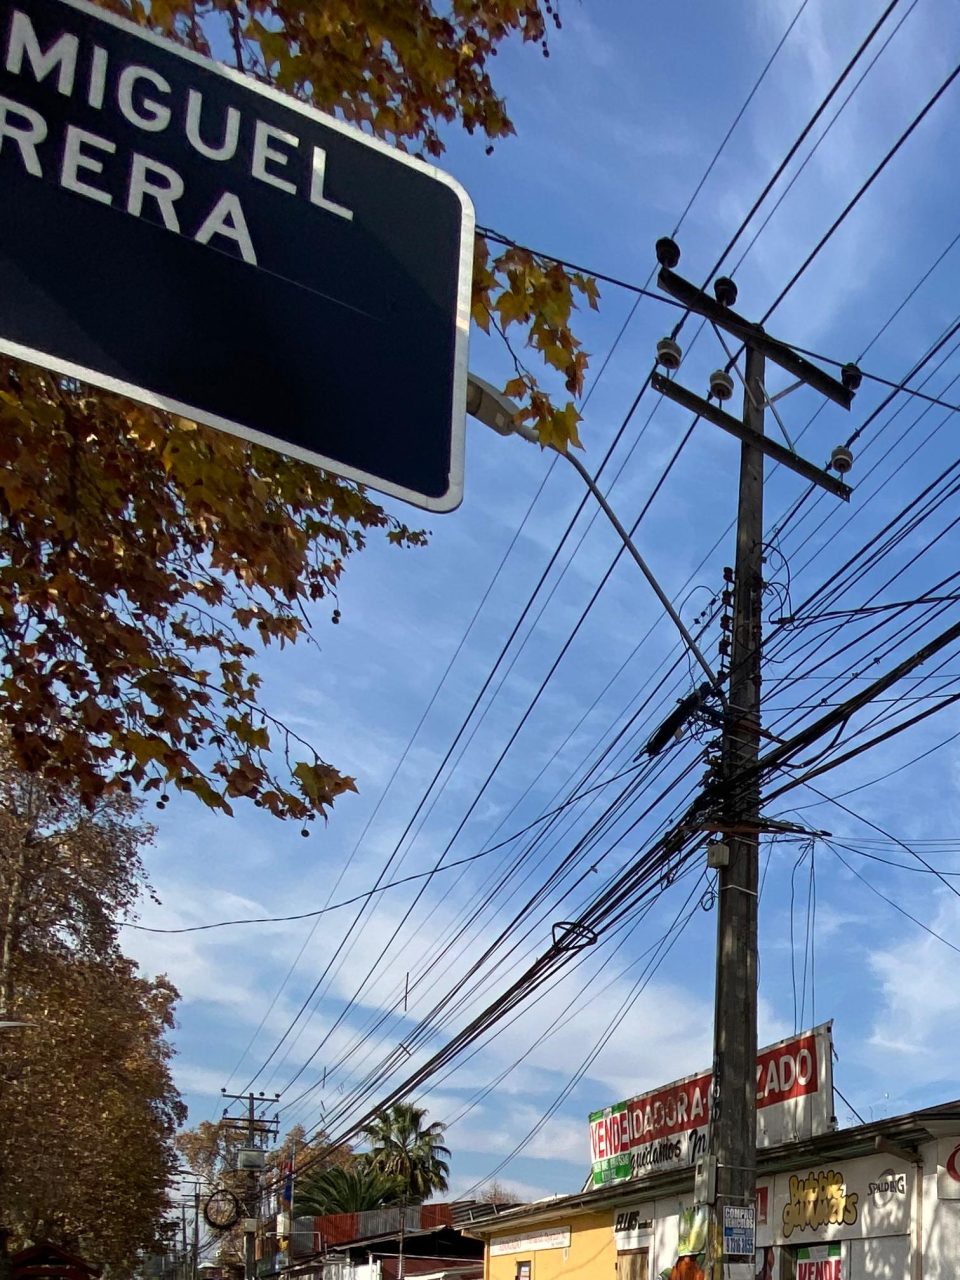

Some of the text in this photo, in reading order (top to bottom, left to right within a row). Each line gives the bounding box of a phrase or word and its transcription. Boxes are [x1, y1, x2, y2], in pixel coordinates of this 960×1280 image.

[6, 9, 353, 221] MIGUEL
[0, 100, 258, 266] RERA
[591, 1112, 629, 1160] VENDE
[867, 1176, 905, 1196] SPALDING
[725, 1208, 753, 1219] COMPRO
